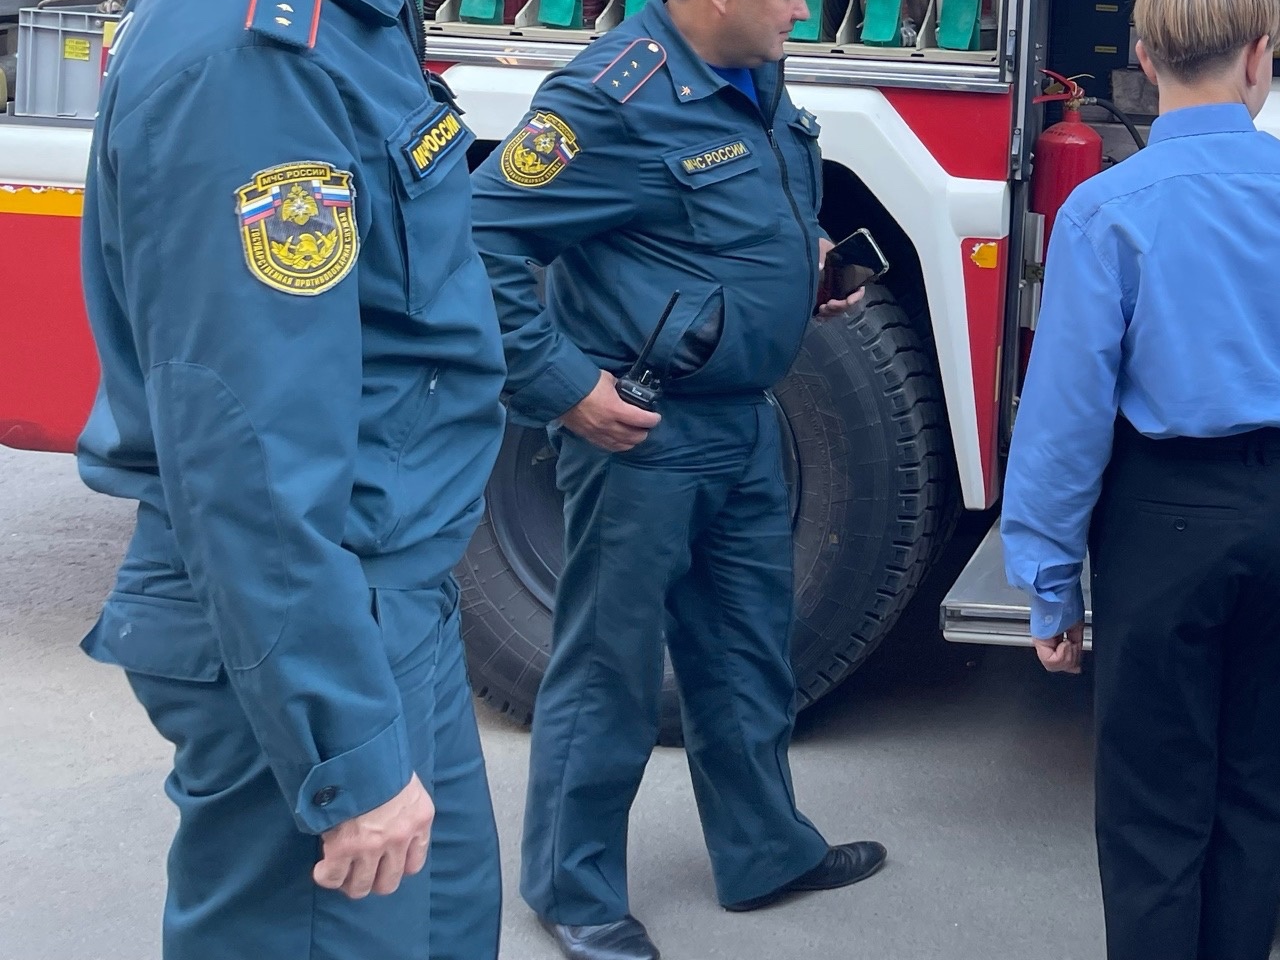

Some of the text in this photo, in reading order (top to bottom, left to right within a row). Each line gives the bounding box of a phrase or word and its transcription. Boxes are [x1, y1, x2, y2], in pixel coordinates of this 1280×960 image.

[683, 142, 747, 171] МЧС РОССИИ
[262, 168, 326, 186] МЧС РОССИИ
